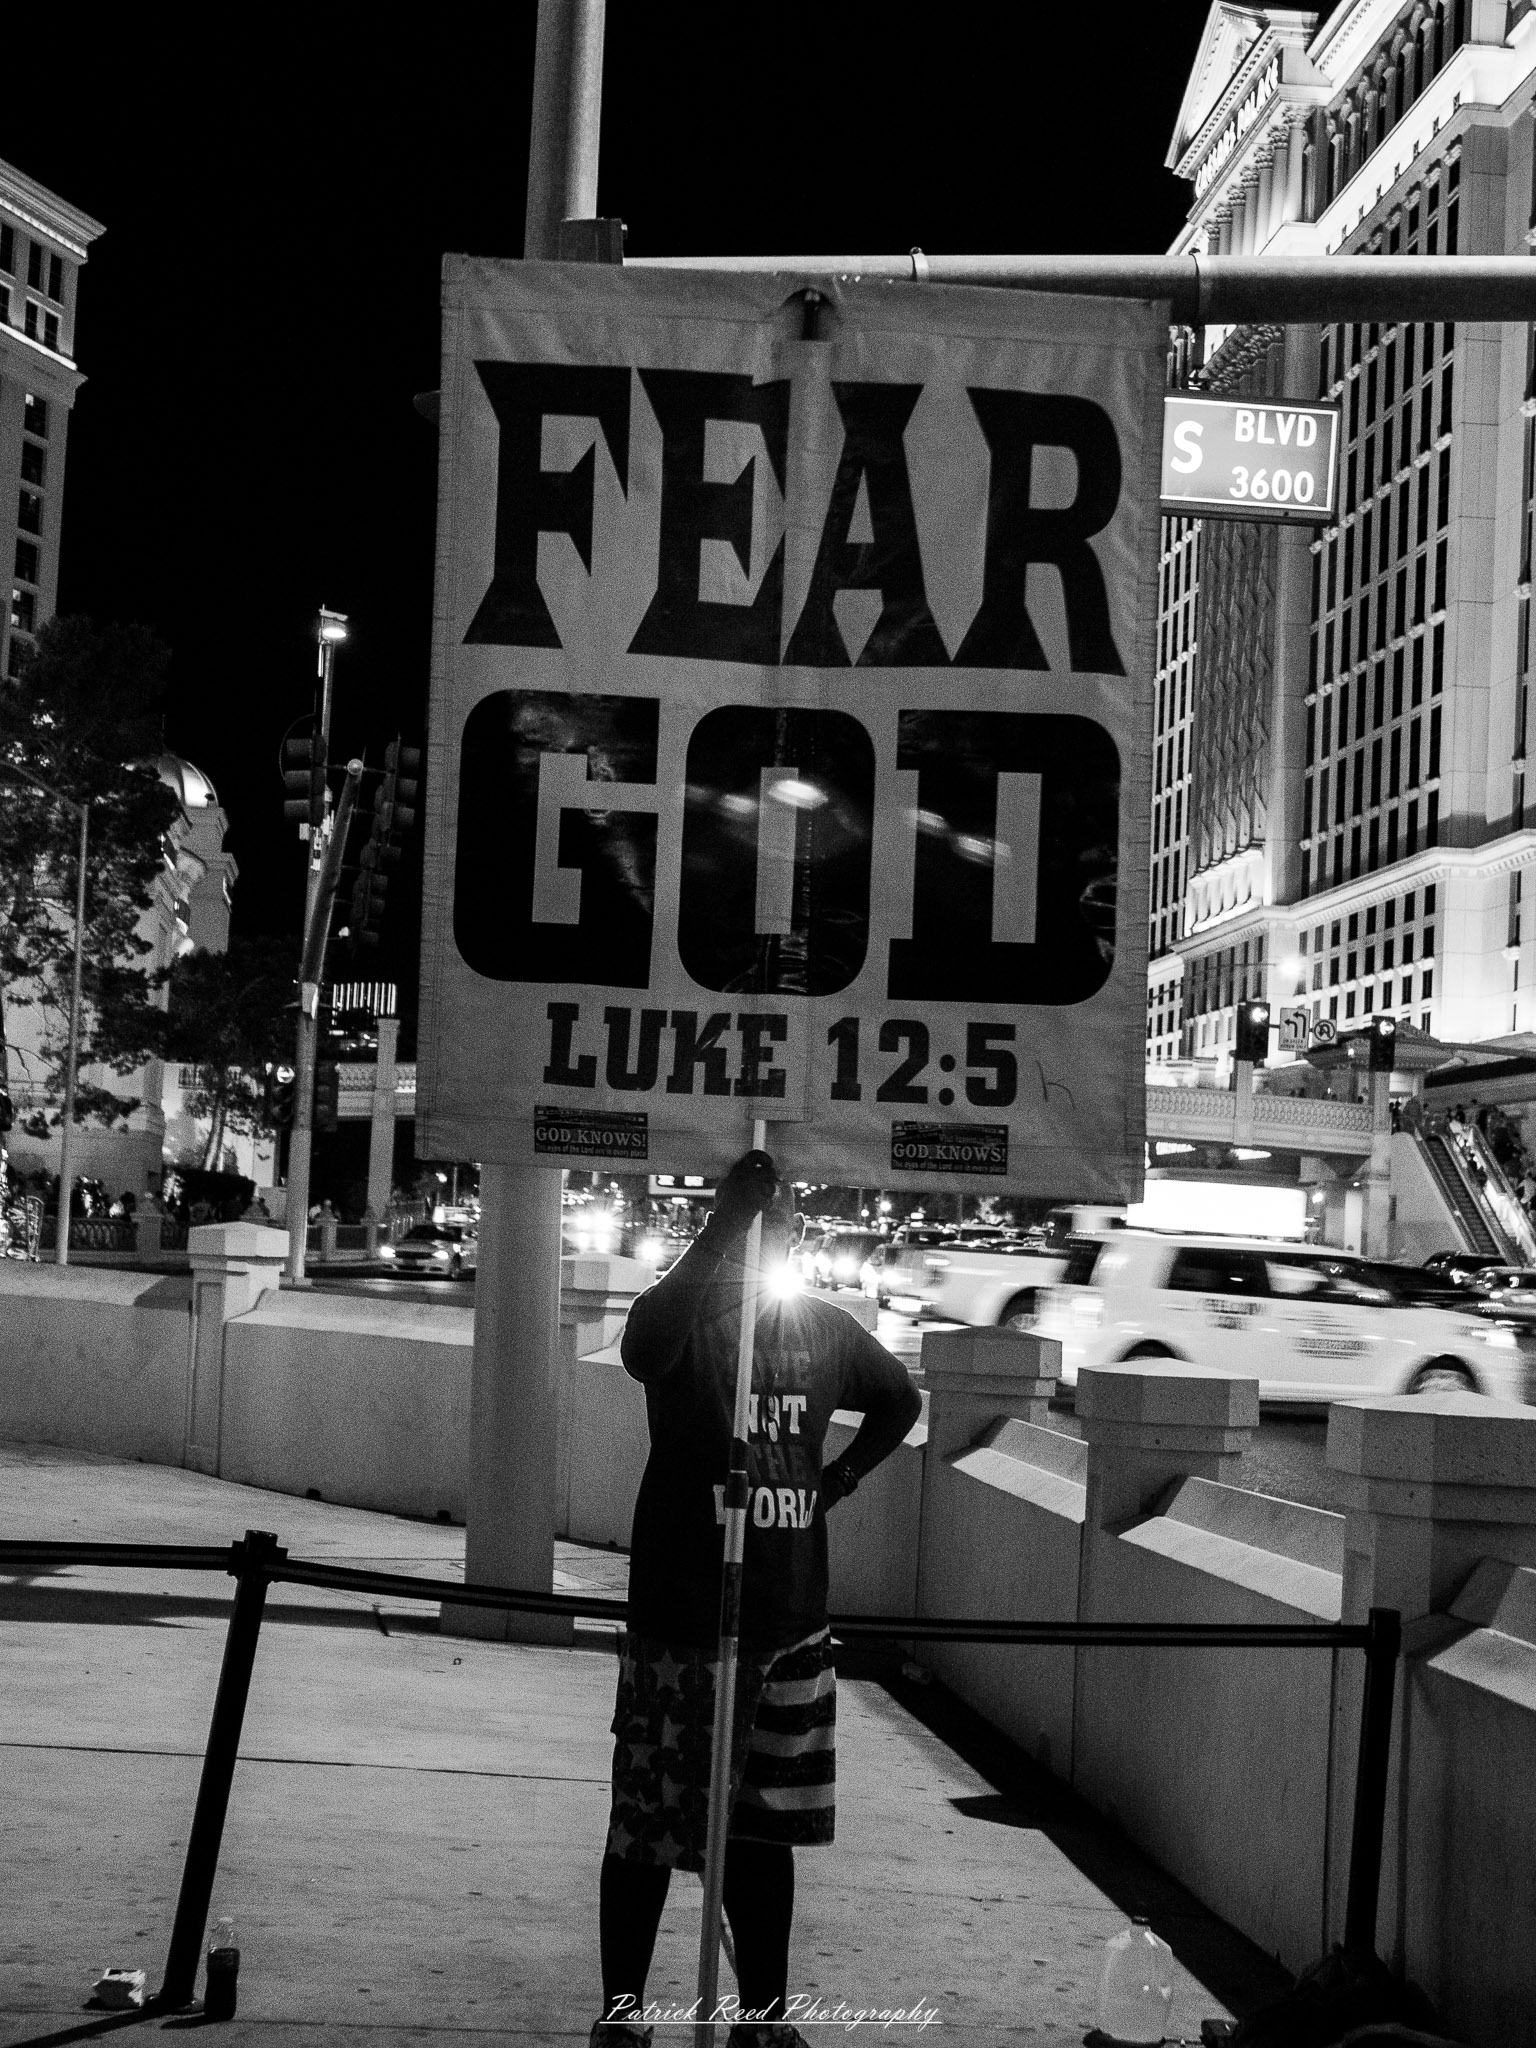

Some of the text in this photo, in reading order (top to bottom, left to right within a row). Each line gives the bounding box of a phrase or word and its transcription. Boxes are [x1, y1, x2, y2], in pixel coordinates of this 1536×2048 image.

[1170, 420, 1204, 474] S
[1234, 409, 1318, 447] BLVD
[1229, 465, 1315, 503] 3600
[462, 359, 1126, 677] FEAR
[453, 688, 1122, 1006] GOD
[543, 1002, 1018, 1108] LUKE 12:5
[535, 1126, 646, 1147] GOD KNOWS!
[893, 1143, 1006, 1163] GOD KNOWS!
